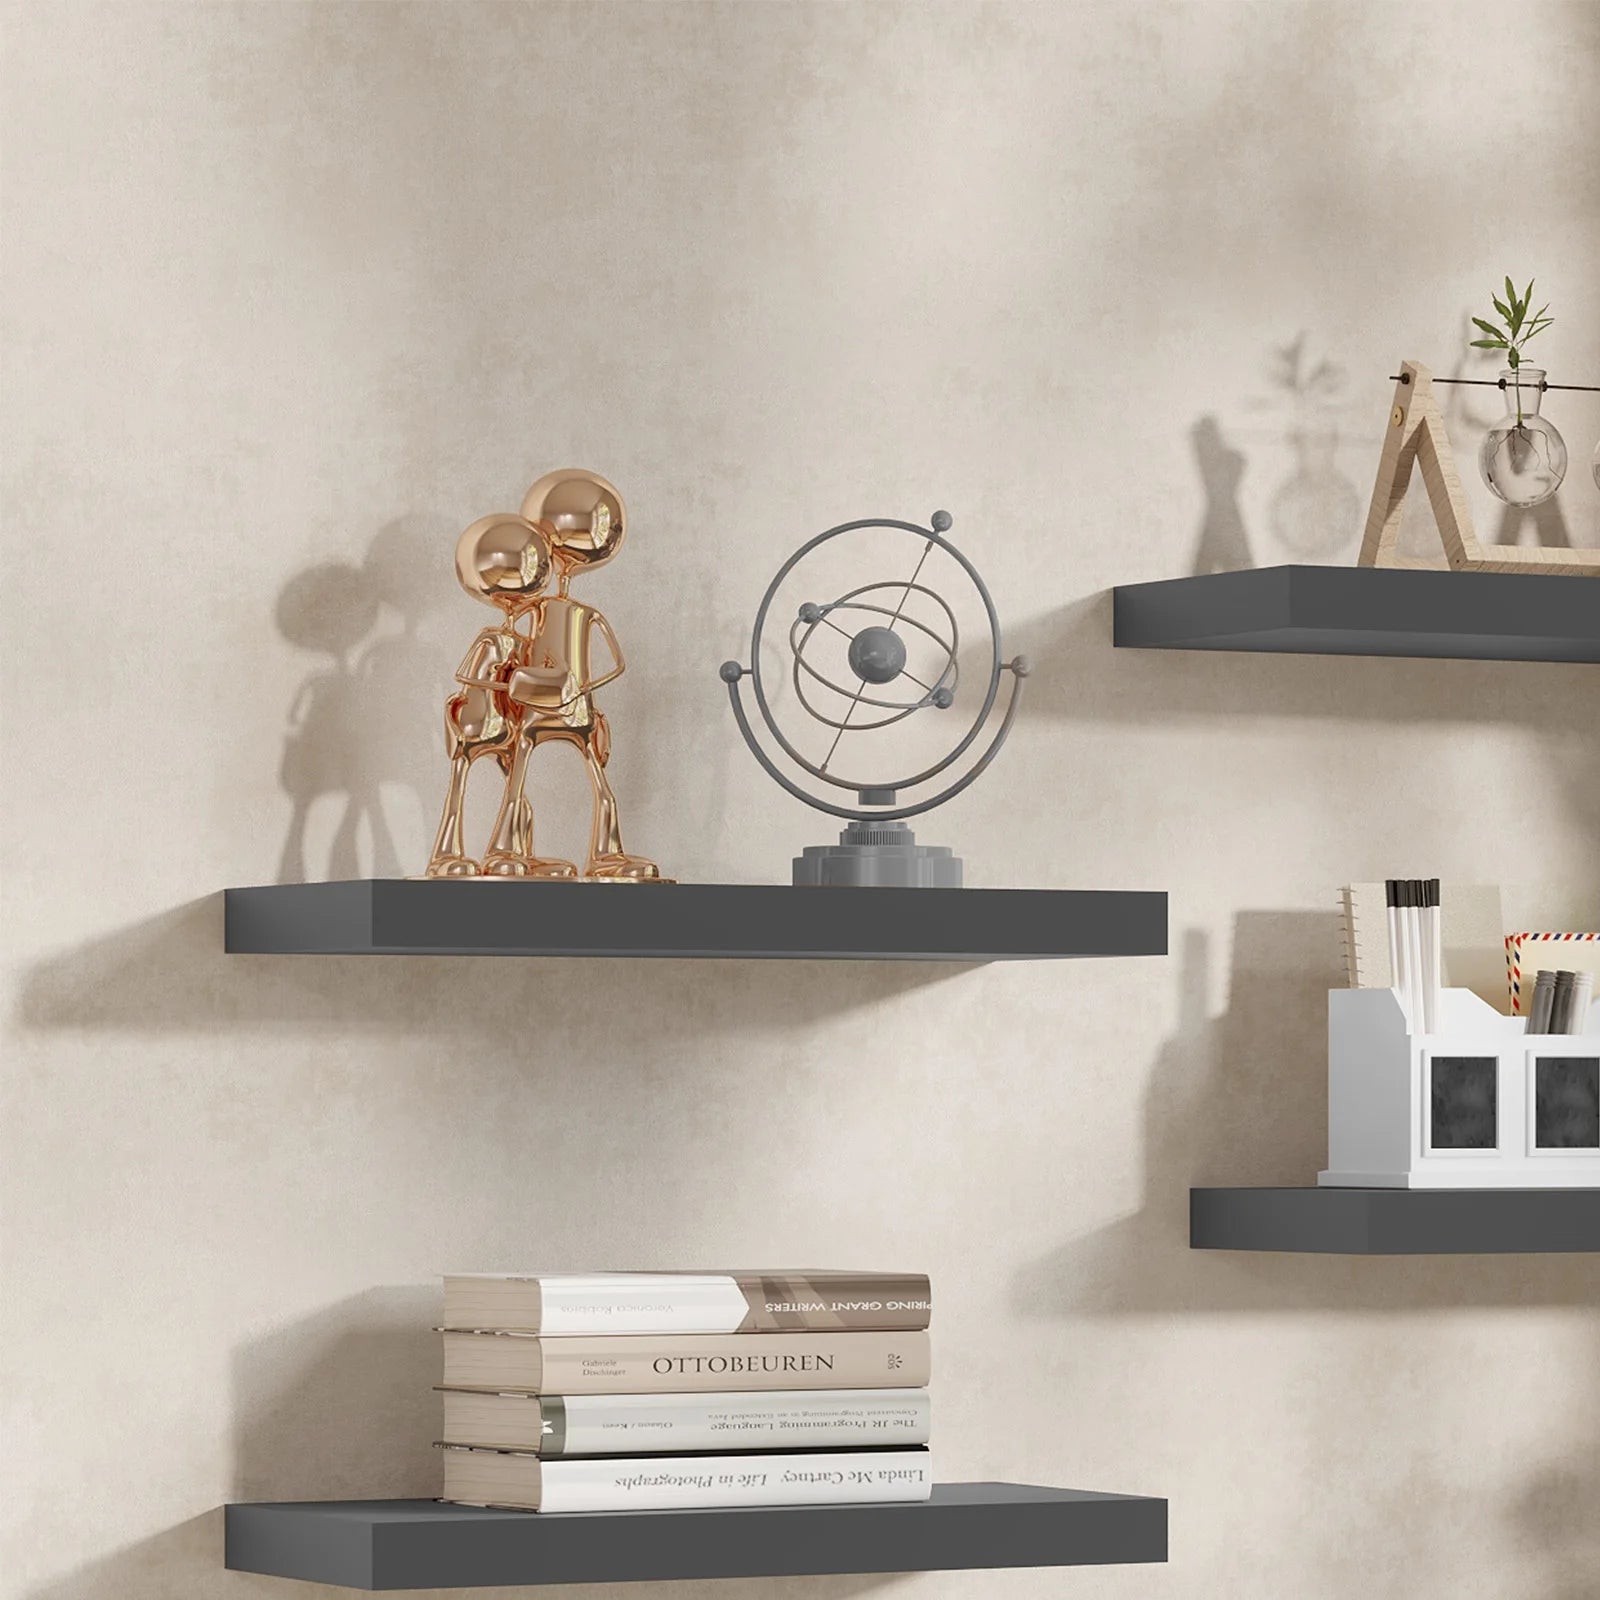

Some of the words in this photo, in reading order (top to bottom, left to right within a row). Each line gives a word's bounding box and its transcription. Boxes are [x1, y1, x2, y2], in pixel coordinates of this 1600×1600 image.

[764, 1302, 826, 1313] WRITERS
[830, 1300, 882, 1312] GRANT
[653, 1354, 835, 1375] OTTOBEUREN
[710, 1421, 774, 1430] Language
[779, 1419, 866, 1429] Programming
[893, 1419, 918, 1428] The
[614, 1473, 713, 1491] Photographs
[718, 1474, 734, 1488] in
[738, 1473, 768, 1488] Life
[879, 1470, 924, 1484] Linda
